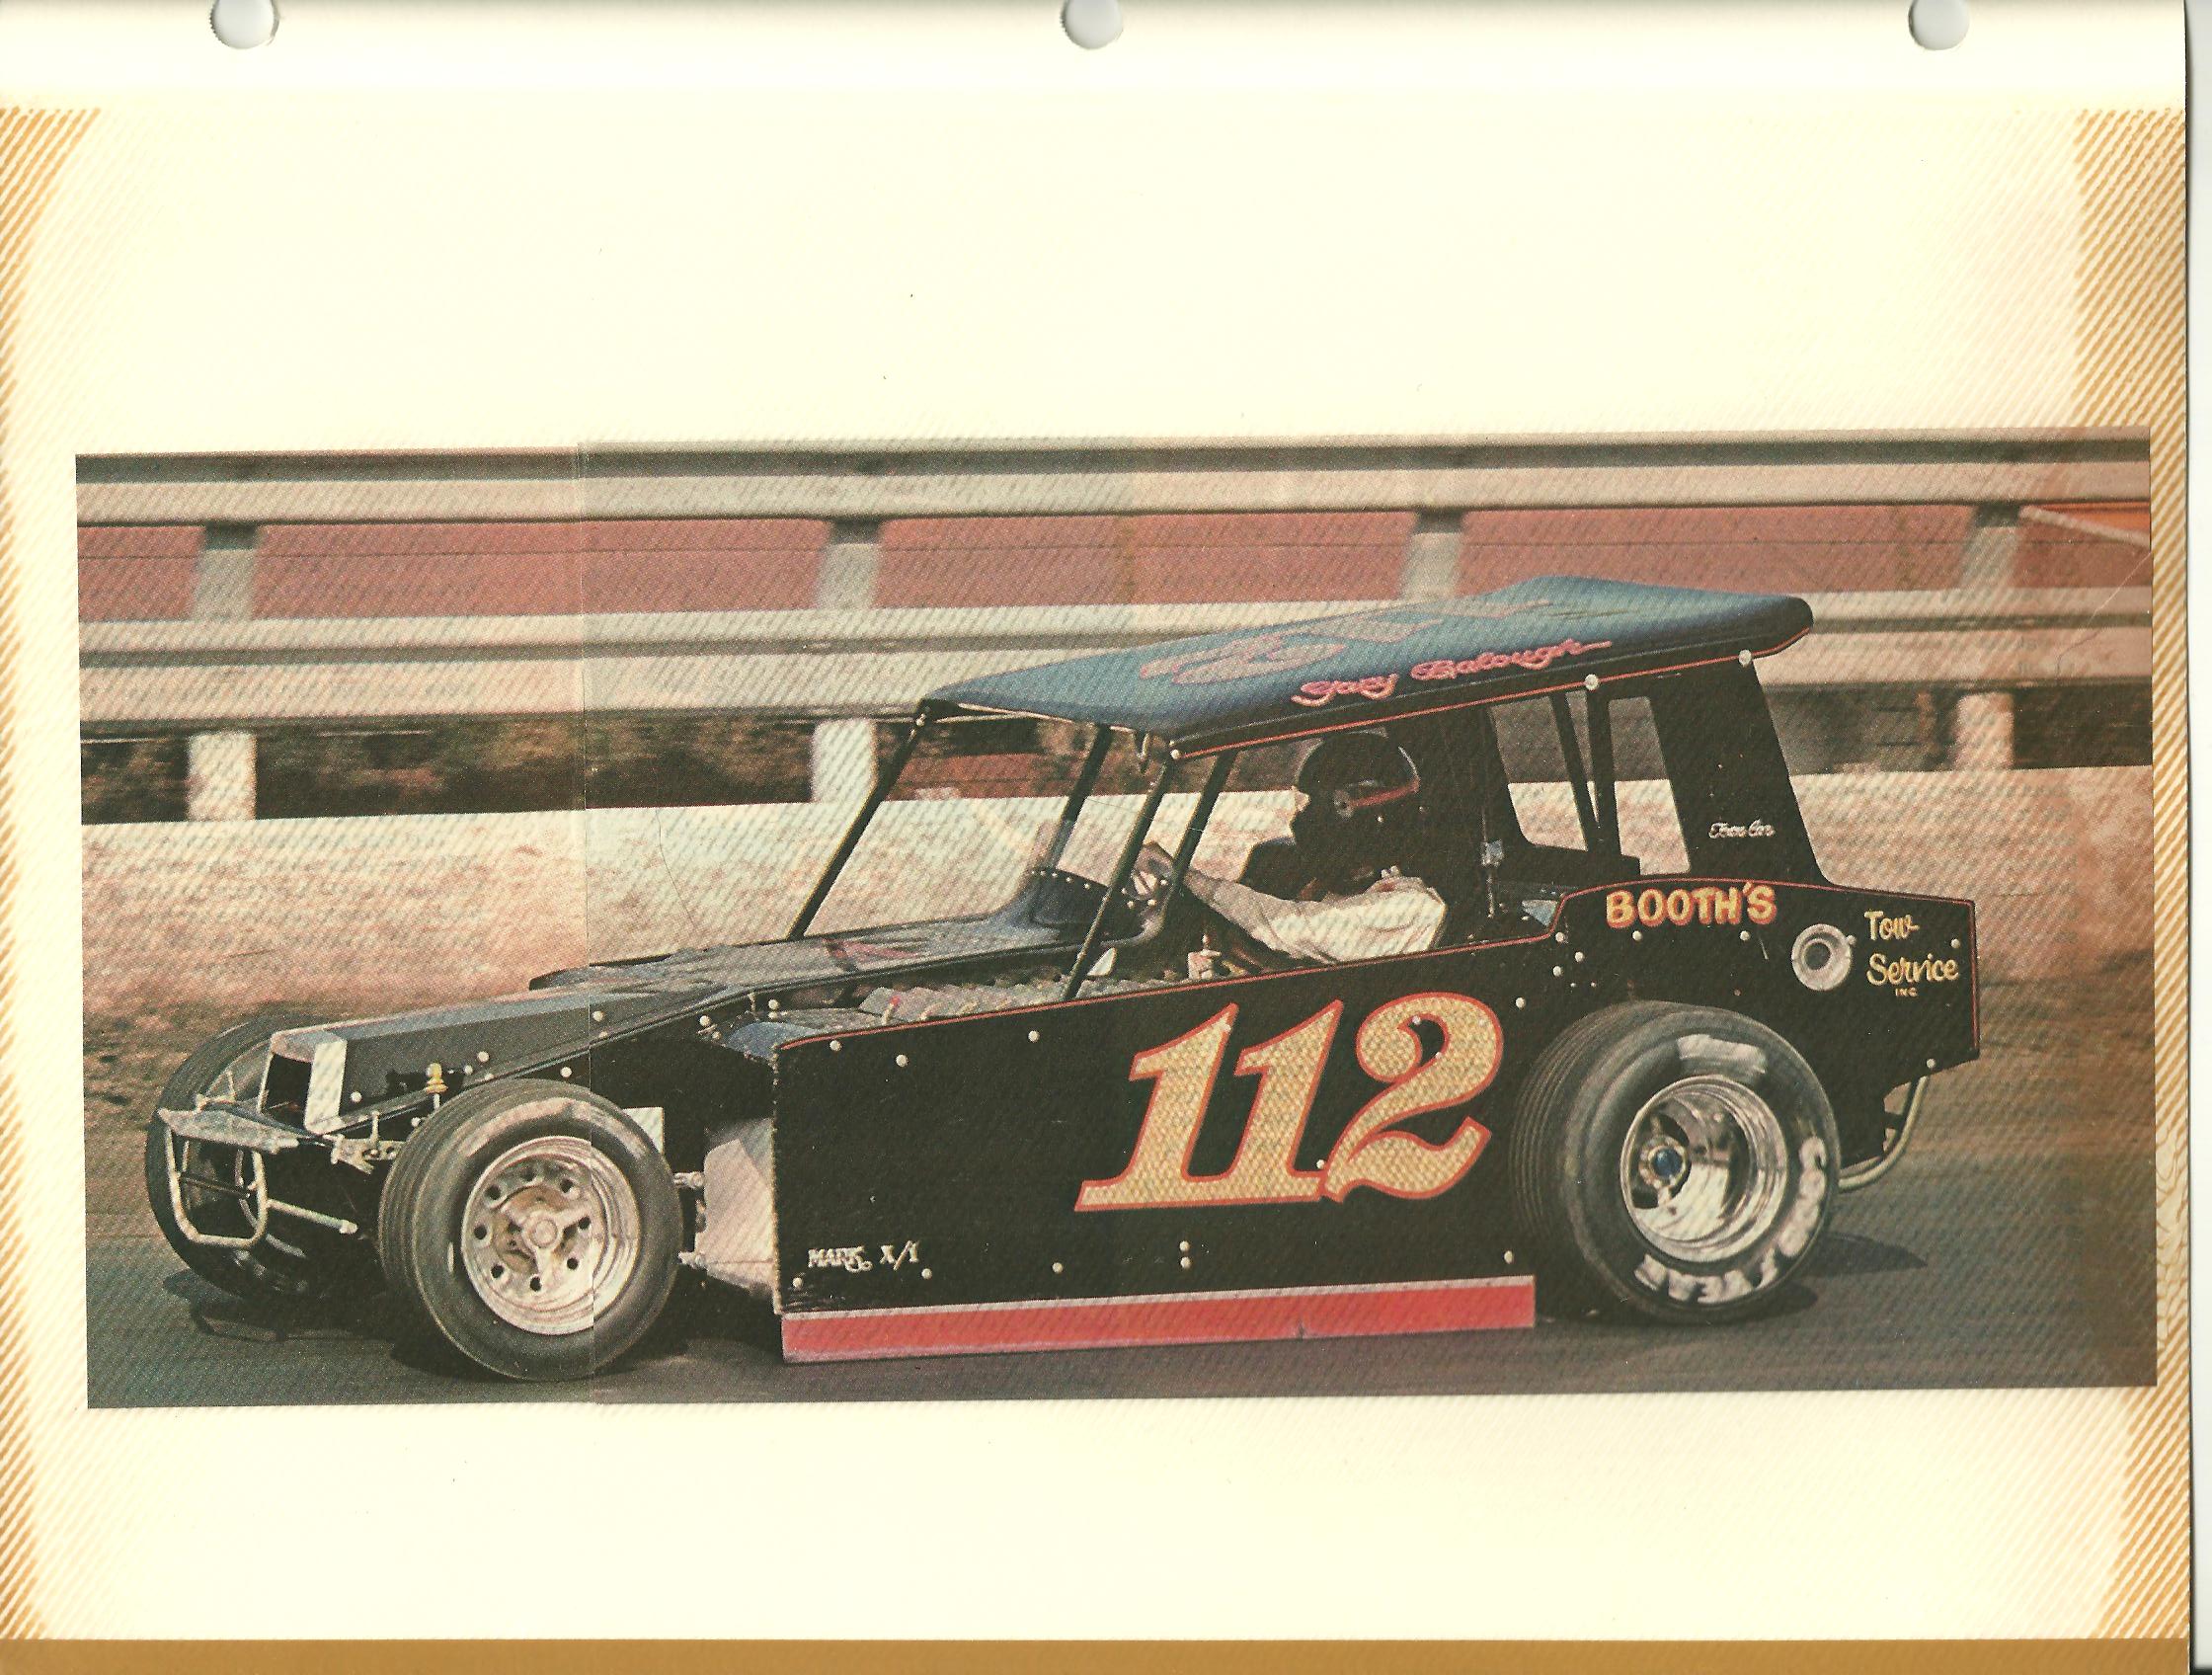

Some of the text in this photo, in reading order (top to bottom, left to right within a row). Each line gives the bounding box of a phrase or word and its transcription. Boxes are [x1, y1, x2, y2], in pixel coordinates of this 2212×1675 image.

[1605, 881, 1778, 929] BOOTH'S
[1863, 910, 1921, 941] Tow
[1866, 952, 1960, 986] Service
[1074, 992, 1504, 1212] 112
[807, 1244, 874, 1274] MARK
